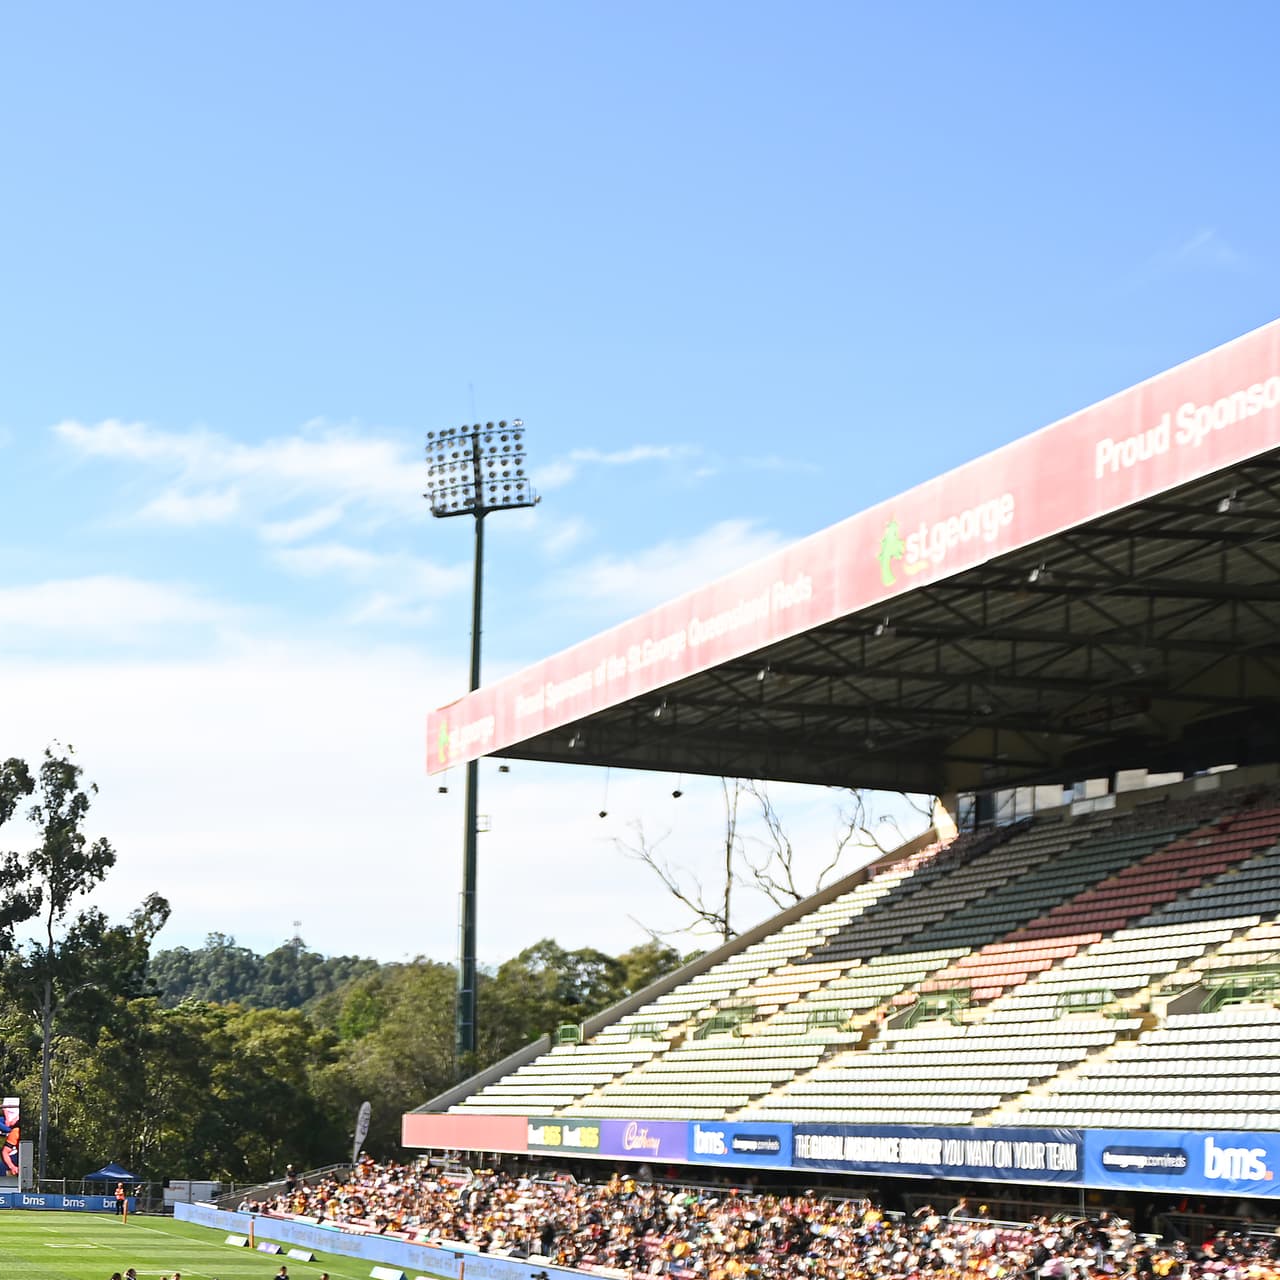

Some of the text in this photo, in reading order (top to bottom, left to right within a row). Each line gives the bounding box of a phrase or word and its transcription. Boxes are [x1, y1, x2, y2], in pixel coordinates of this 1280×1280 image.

[1095, 412, 1171, 479] Proud
[904, 493, 1015, 563] st.george
[688, 587, 771, 646] Queensland
[772, 571, 813, 611] Reds
[623, 1121, 661, 1156] Cadbury
[795, 1135, 1078, 1171] THE GLOBAL INSURANCE BROKER YOU WANT ON YOUR TEAM
